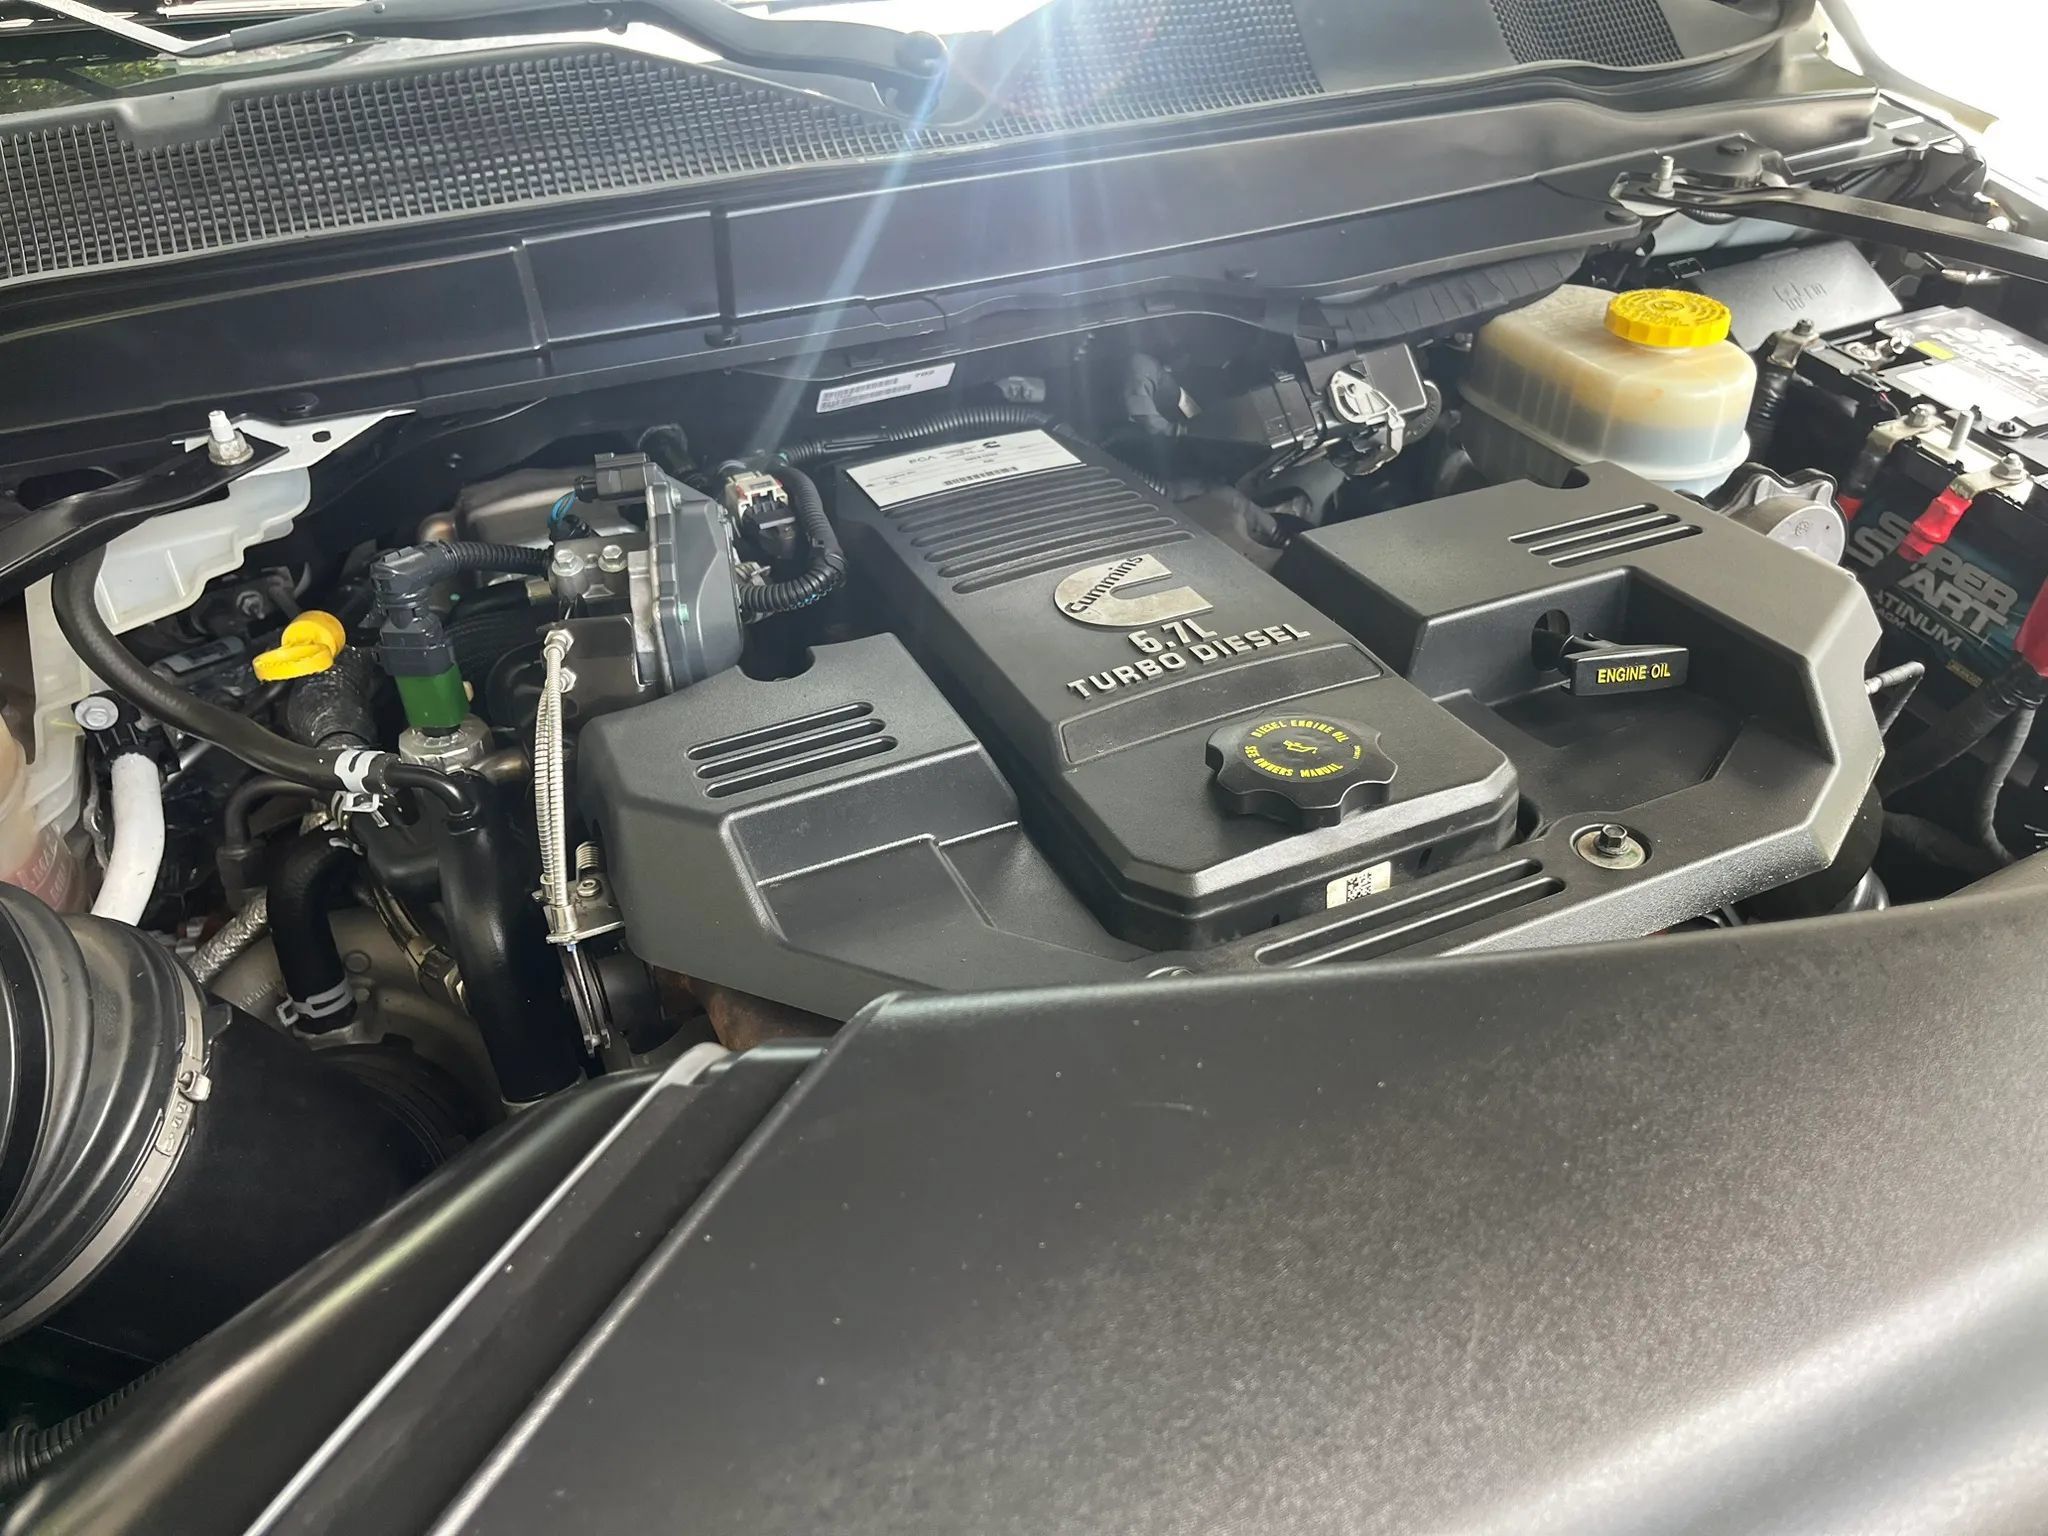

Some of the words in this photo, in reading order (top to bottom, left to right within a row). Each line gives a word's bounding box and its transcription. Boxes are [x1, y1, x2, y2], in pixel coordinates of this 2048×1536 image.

[1064, 555, 1143, 614] Cummins
[1846, 526, 2009, 634] SART
[1878, 511, 2018, 615] SPER
[1128, 618, 1217, 653] 6.7L
[1066, 652, 1187, 700] TURBO
[1189, 623, 1311, 664] DIESEL
[1597, 665, 1648, 684] ENGINE
[1651, 663, 1671, 679] OIL
[1250, 720, 1287, 738] DIESEL
[1290, 720, 1334, 734] ENGINE
[1331, 731, 1349, 743] OIL
[1244, 745, 1260, 758] SEE
[1253, 758, 1294, 777] OWNERS
[1300, 763, 1343, 777] MANUAL
